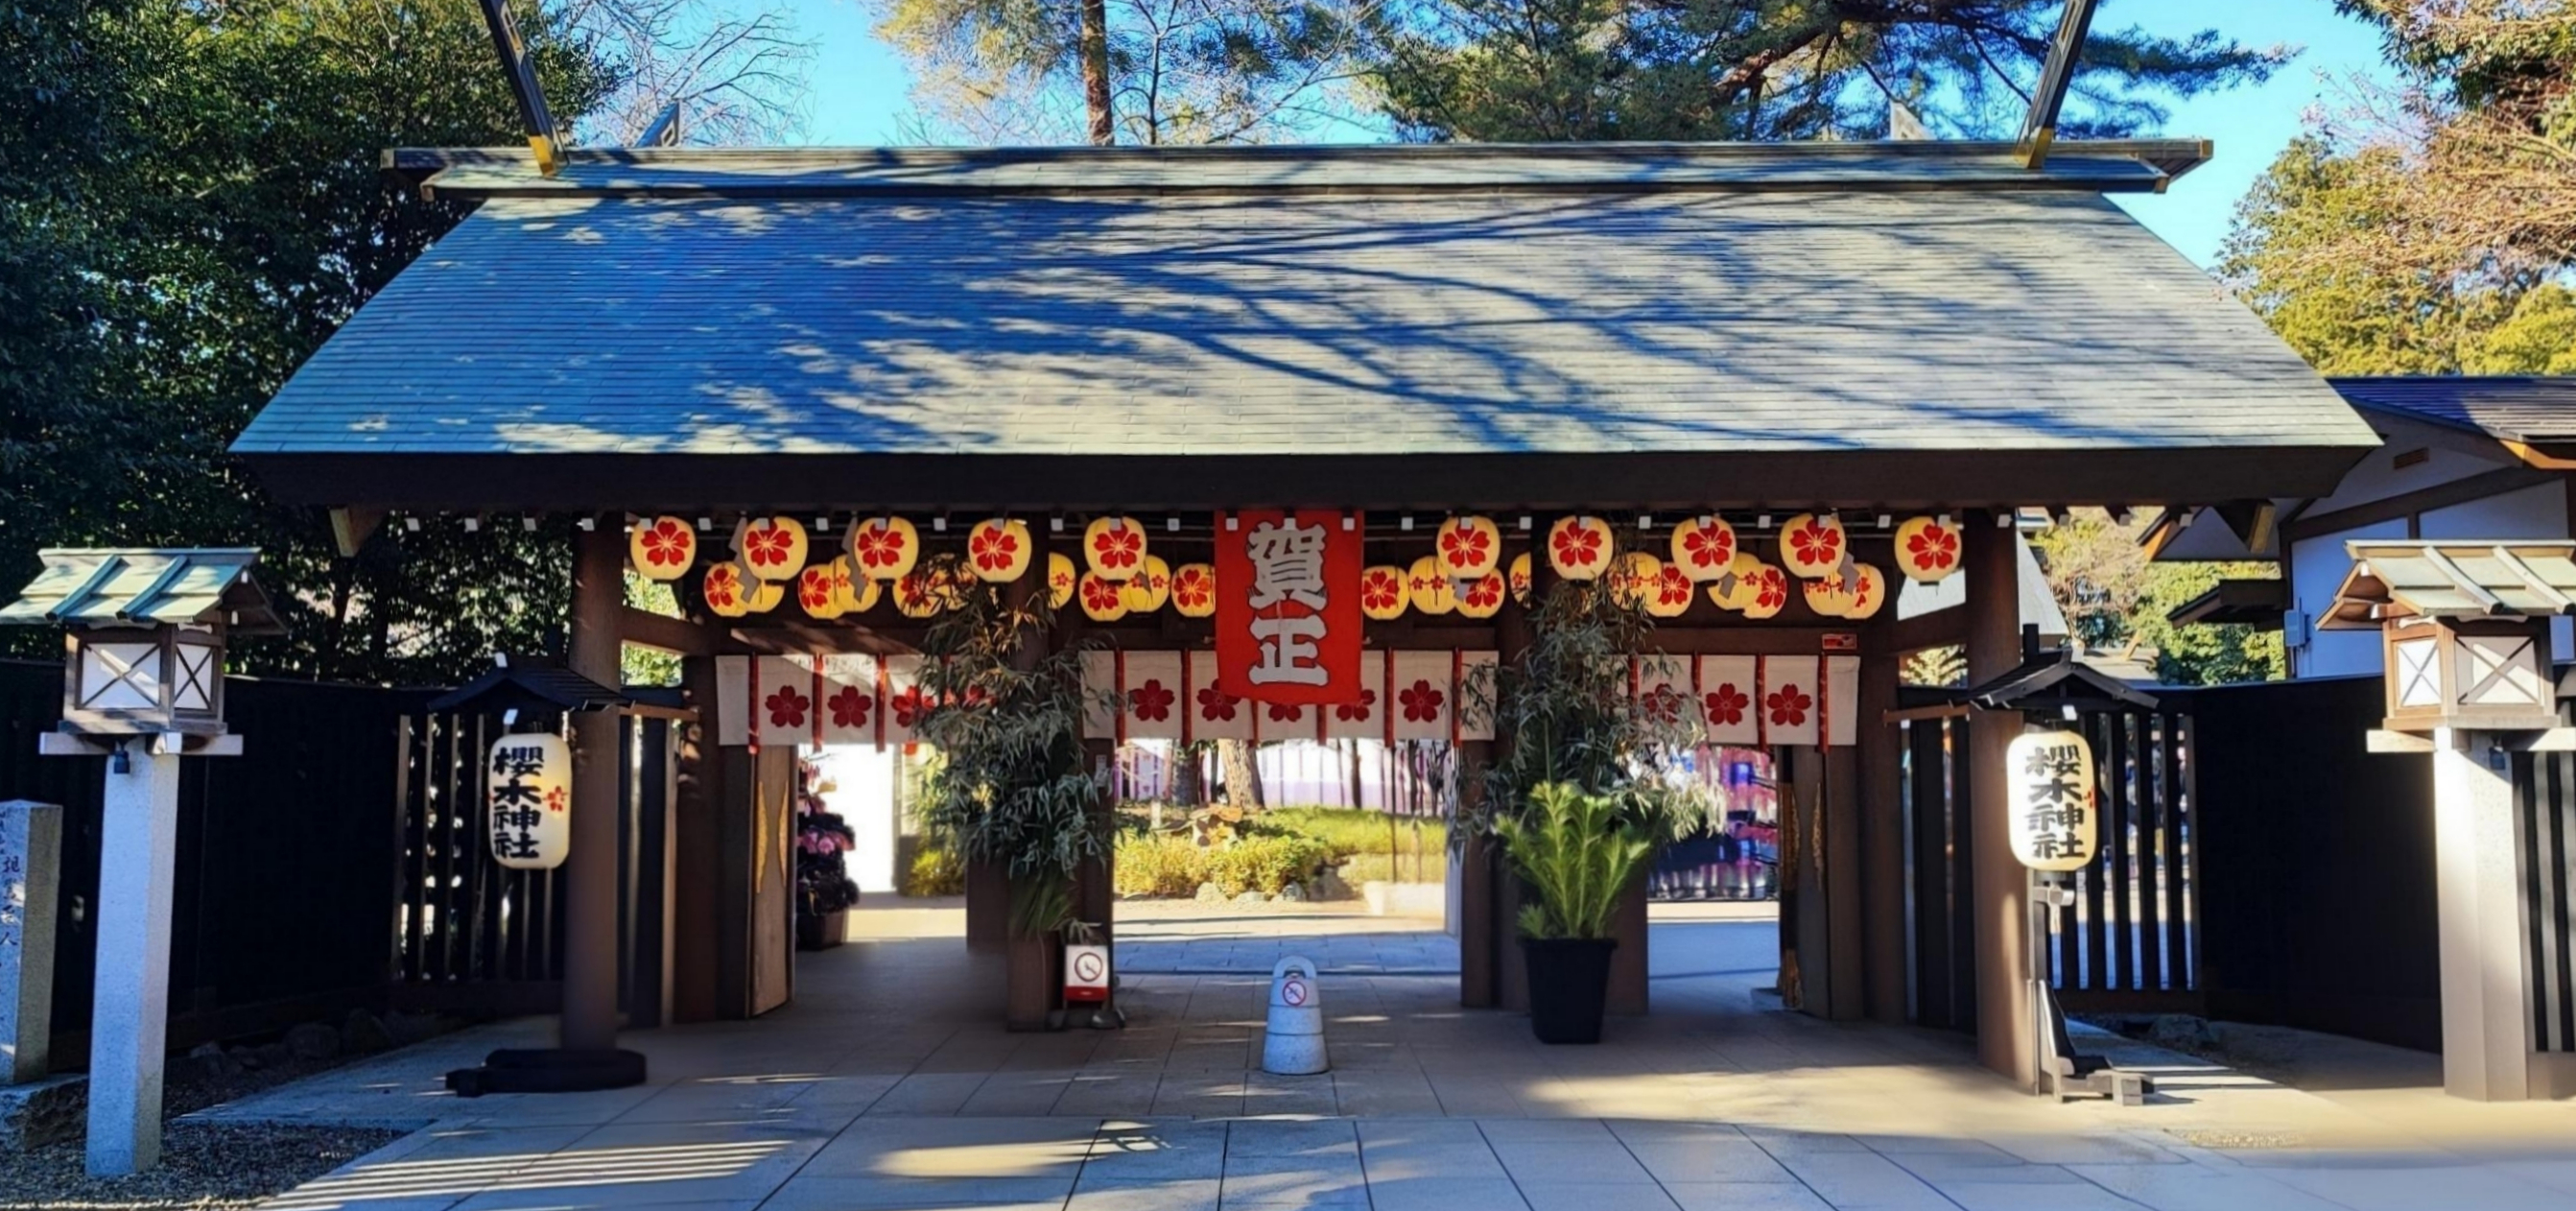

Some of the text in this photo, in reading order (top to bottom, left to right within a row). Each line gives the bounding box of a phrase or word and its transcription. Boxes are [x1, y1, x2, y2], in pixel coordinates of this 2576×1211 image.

[1247, 521, 1329, 686] 賀正
[493, 746, 544, 859] 櫻木神社
[2025, 745, 2087, 860] 櫻木神社
